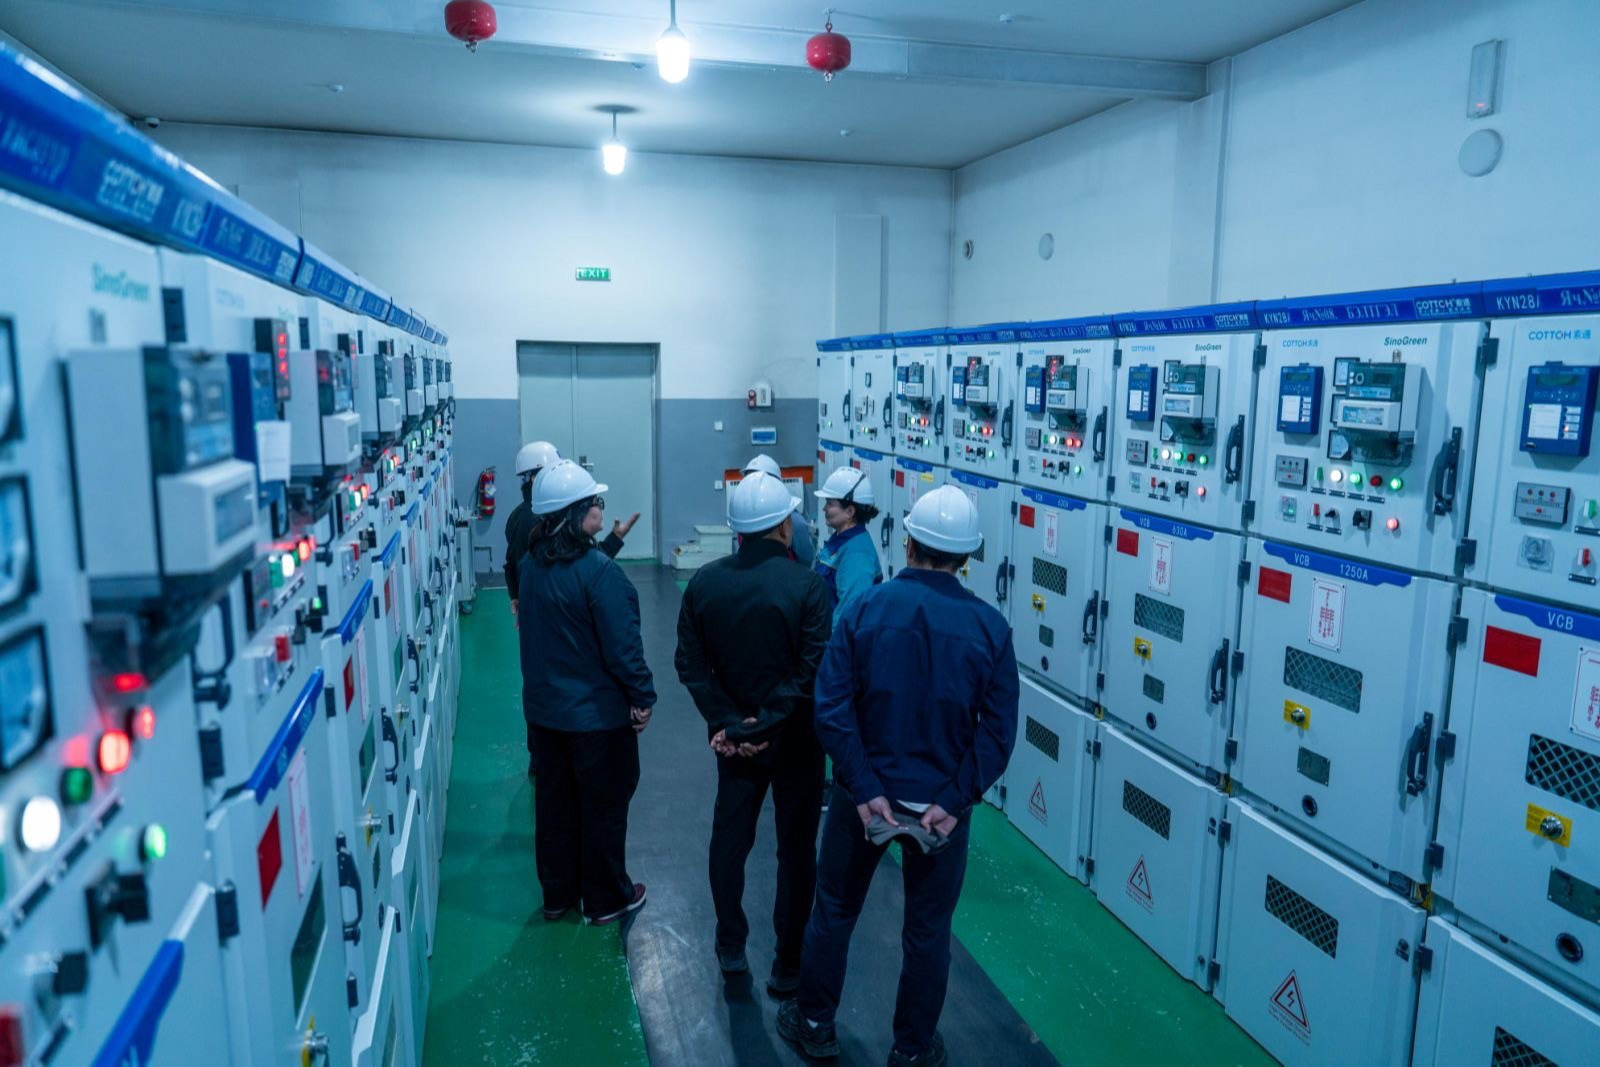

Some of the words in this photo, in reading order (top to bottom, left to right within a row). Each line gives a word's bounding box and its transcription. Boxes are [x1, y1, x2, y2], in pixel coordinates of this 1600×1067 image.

[580, 269, 607, 278] EXIT
[1384, 336, 1427, 346] SinoGreen
[1528, 330, 1571, 340] COTTOH
[1171, 524, 1188, 538] 630A
[1294, 552, 1310, 567] VCB
[1340, 563, 1369, 581] 1250A
[1547, 611, 1574, 631] VCB
